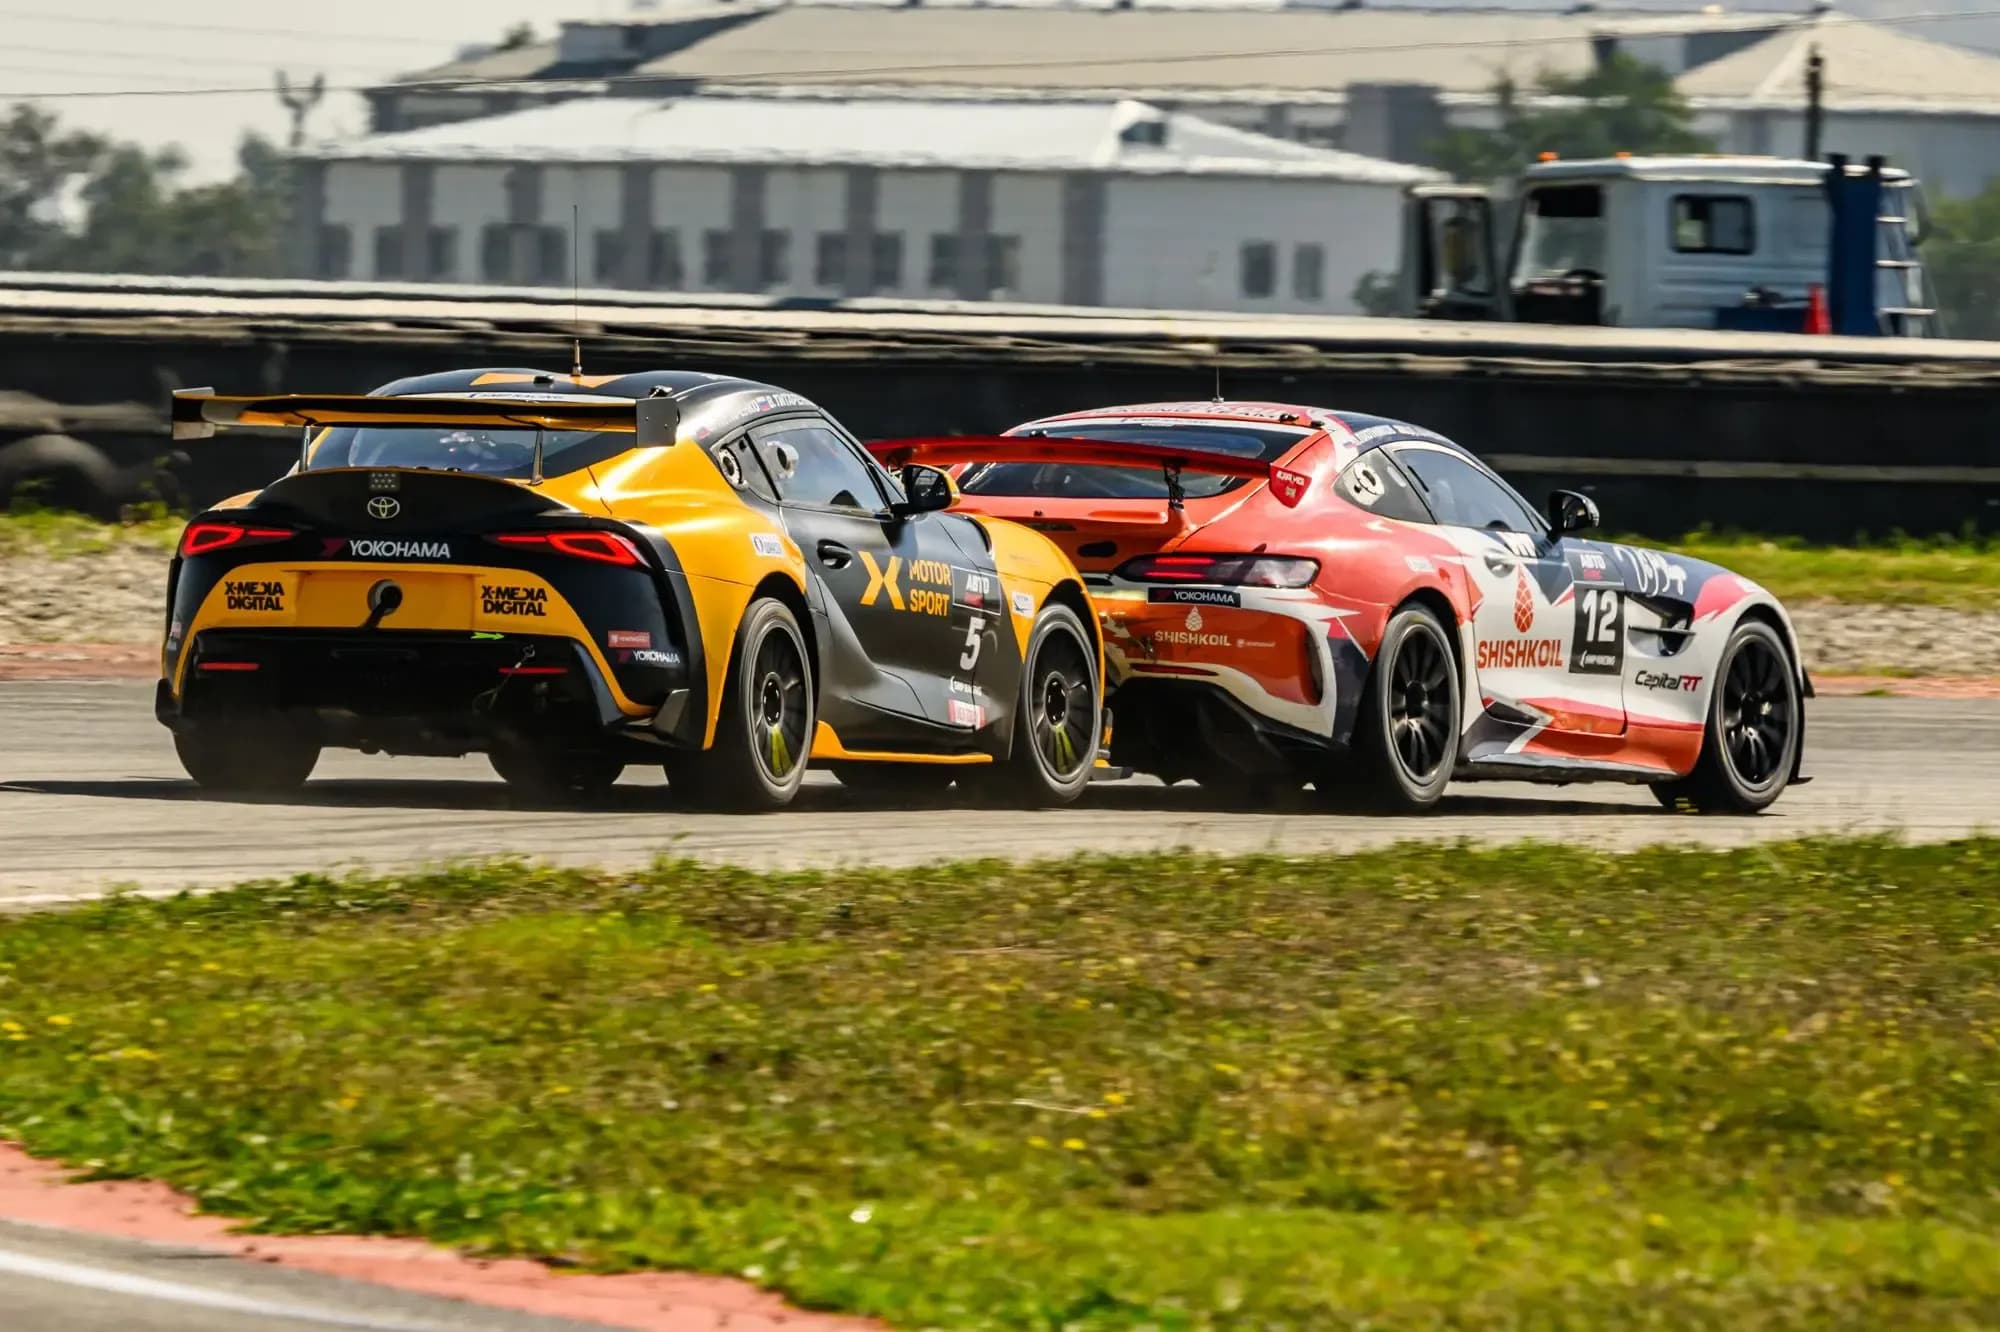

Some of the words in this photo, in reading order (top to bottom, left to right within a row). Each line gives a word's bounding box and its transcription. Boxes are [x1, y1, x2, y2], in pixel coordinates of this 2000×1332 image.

[349, 540, 451, 559] YOKOHAMA
[908, 559, 952, 586] MOTOR
[227, 596, 285, 611] DIGITAL
[909, 589, 950, 617] SPORT
[1174, 590, 1235, 603] YOKOHAMA
[483, 600, 547, 616] DIGITAL
[1582, 589, 1618, 643] 12
[959, 616, 986, 671] 5
[1154, 630, 1232, 647] SHISHKOIL
[633, 650, 681, 664] YOKOHAMA
[1477, 639, 1564, 669] SHISHKOIL
